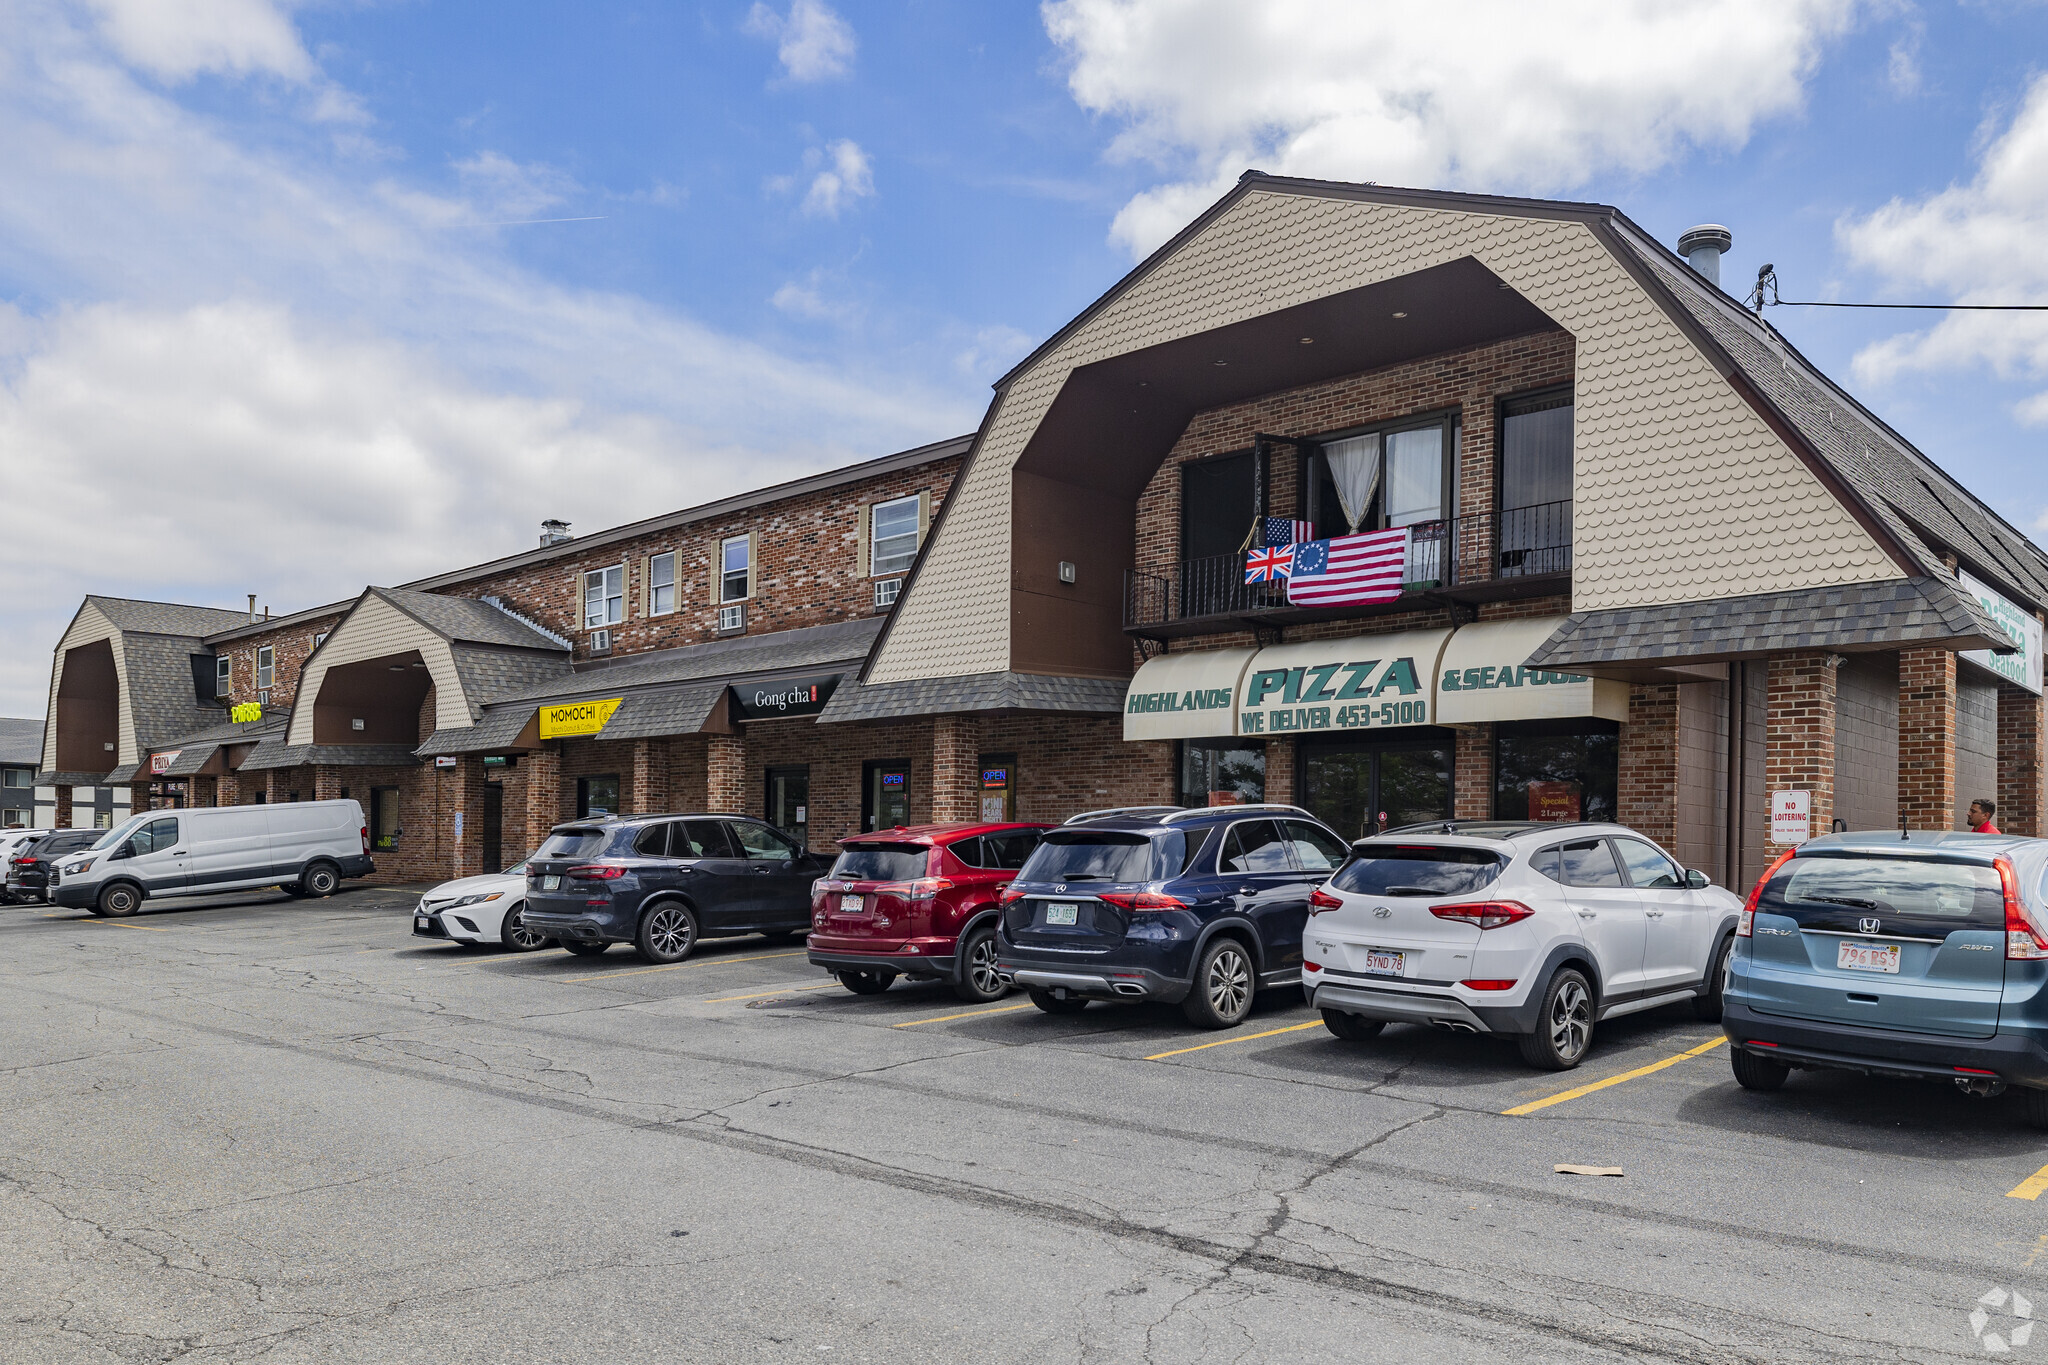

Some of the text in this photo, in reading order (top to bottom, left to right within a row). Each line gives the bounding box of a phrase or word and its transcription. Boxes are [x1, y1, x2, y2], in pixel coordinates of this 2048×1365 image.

[1246, 656, 1422, 707] PIZZA
[755, 690, 787, 711] Gong
[788, 686, 810, 704] cha
[1127, 687, 1232, 714] HIGHLANDS
[550, 705, 596, 723] MOMOCHI
[1241, 700, 1426, 734] WE DELIVER 453-5100
[883, 775, 903, 785] OPEN
[983, 771, 1006, 781] OPEN
[982, 797, 1003, 809] MINI
[1540, 795, 1569, 808] Special
[1785, 802, 1796, 810] NO
[1541, 809, 1569, 819] 2 Large
[1774, 813, 1807, 821] LOITERING
[1958, 944, 1994, 952] AWD
[1367, 955, 1389, 969] 5YND
[1391, 957, 1403, 971] 78
[1840, 948, 1897, 967] 796 RS3
